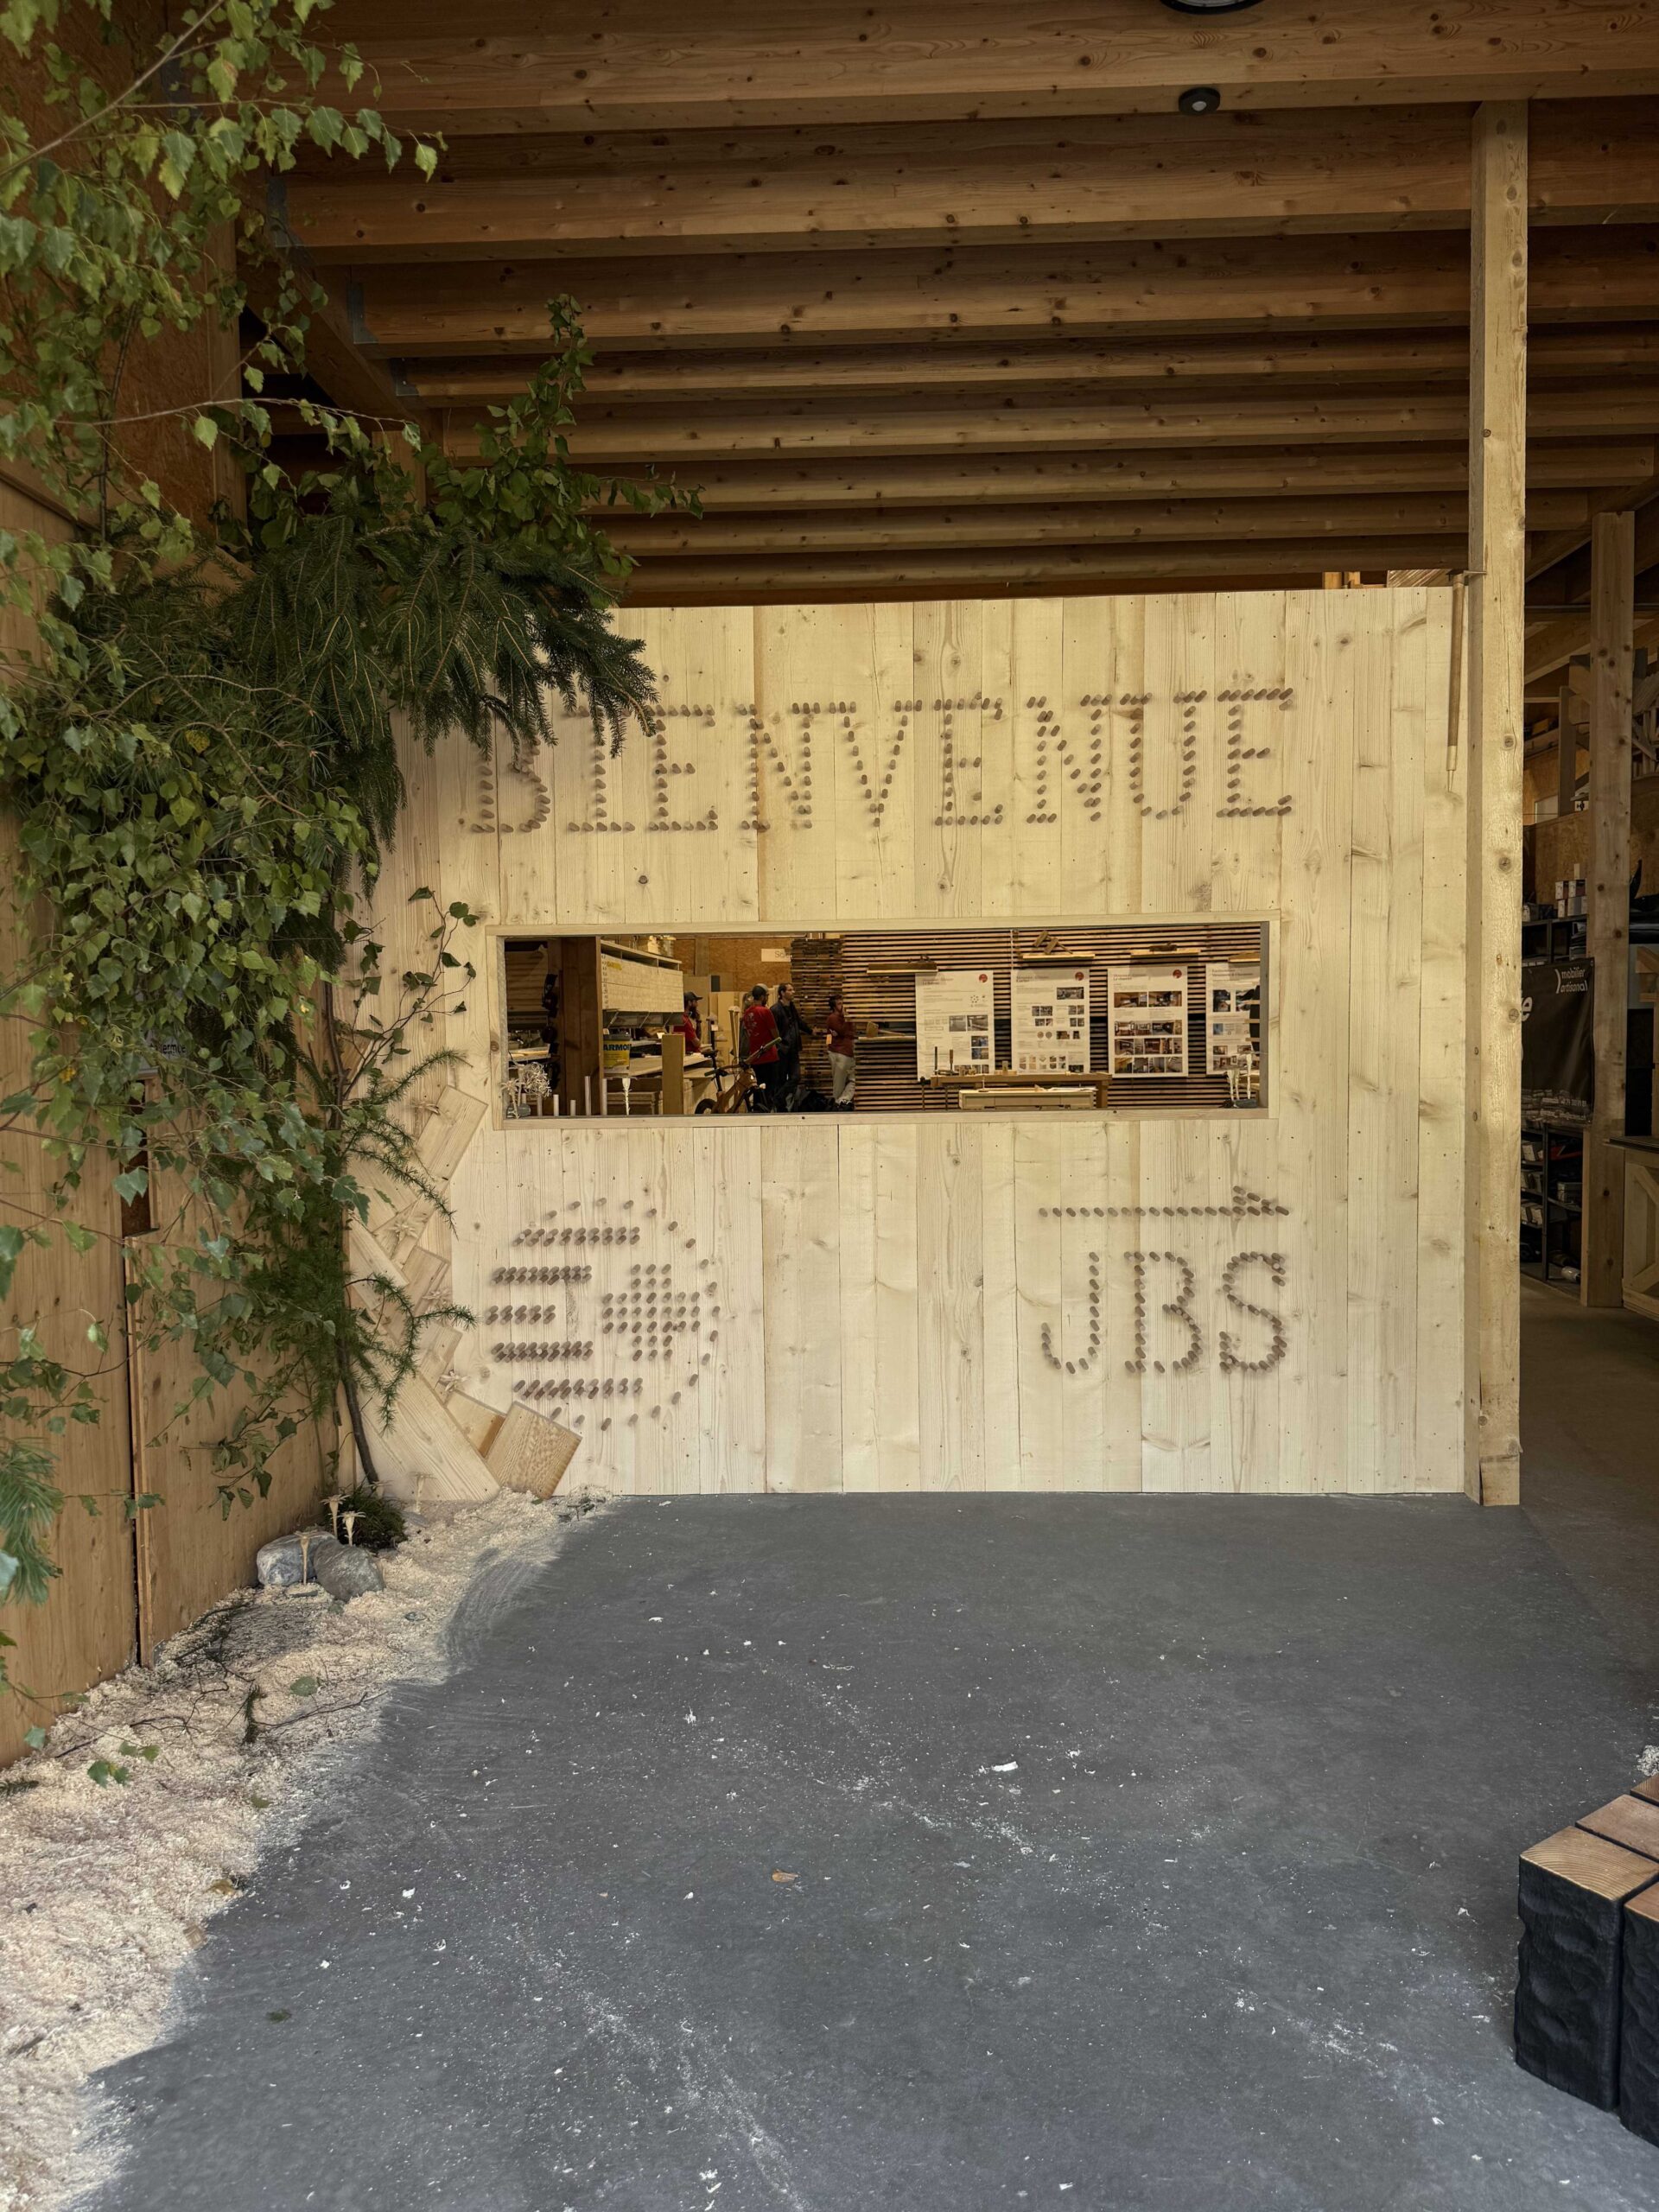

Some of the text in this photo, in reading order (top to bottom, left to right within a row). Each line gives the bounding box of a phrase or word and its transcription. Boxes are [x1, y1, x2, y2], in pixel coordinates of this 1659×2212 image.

[1561, 966, 1586, 979] mobilier
[1560, 979, 1588, 993] artisanal
[1040, 1251, 1288, 1375] JBS
